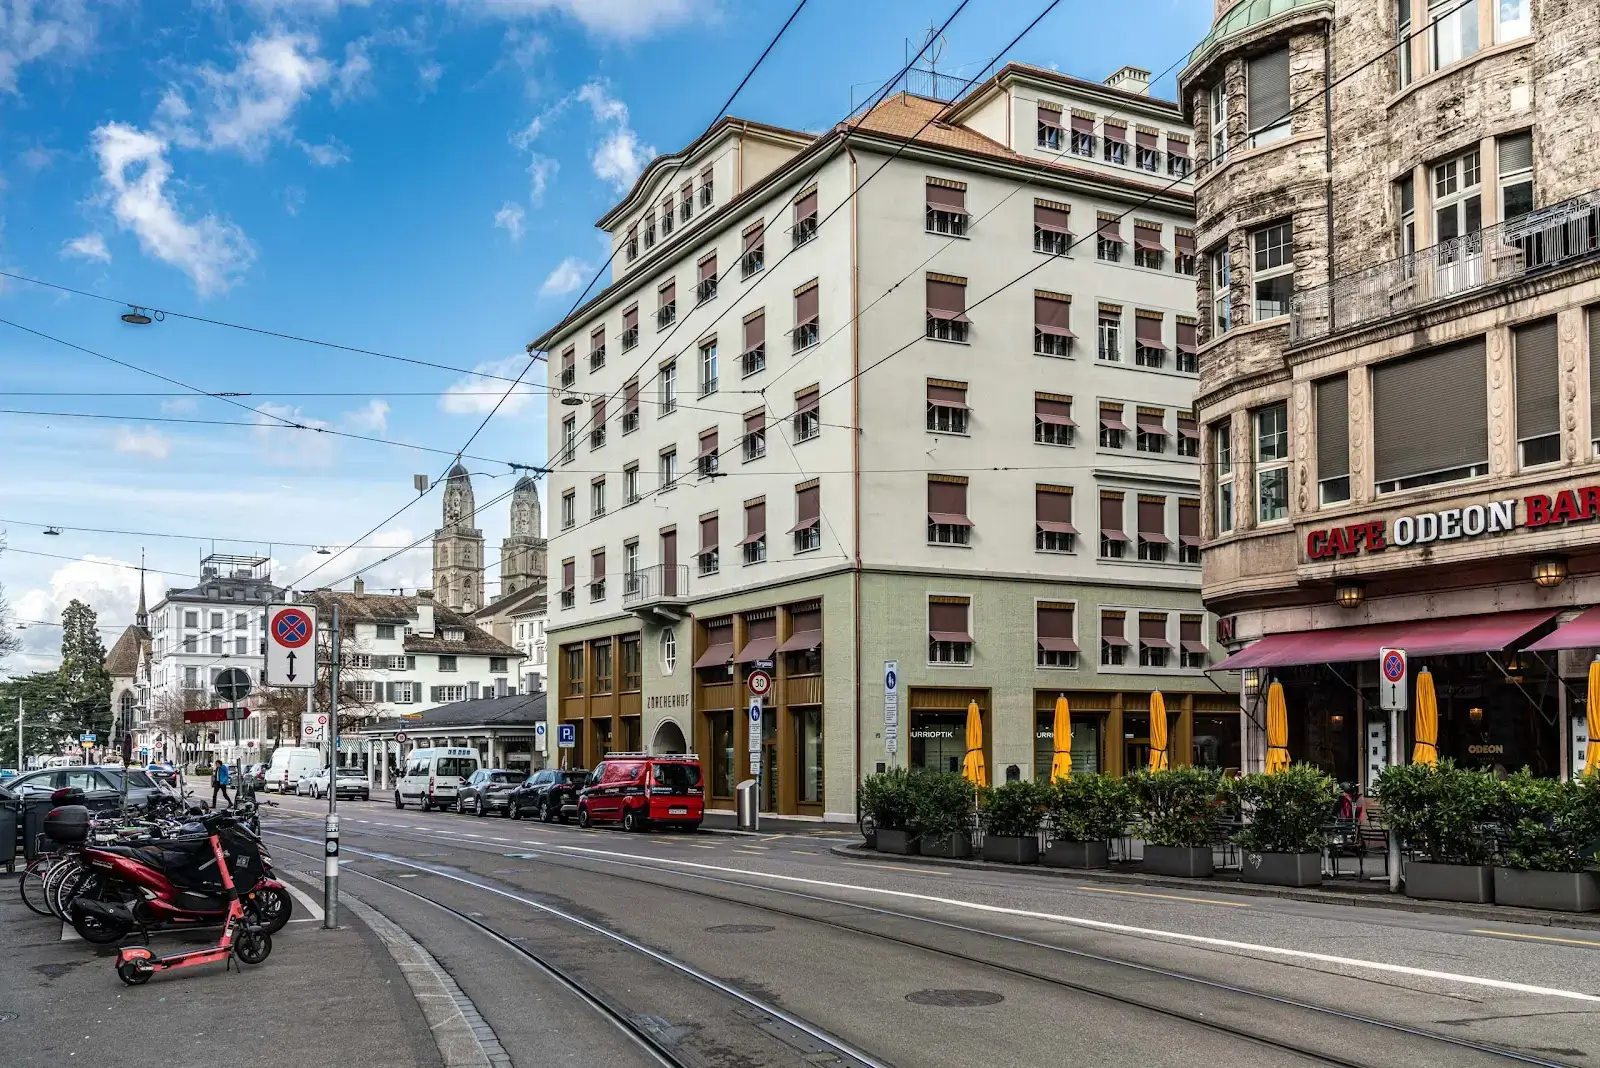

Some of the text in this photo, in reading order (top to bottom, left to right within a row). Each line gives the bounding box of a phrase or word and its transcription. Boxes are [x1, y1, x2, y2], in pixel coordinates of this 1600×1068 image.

[1307, 485, 1600, 560] CAFE ODEON BAR
[755, 678, 764, 688] 30
[1468, 744, 1504, 754] ODEON
